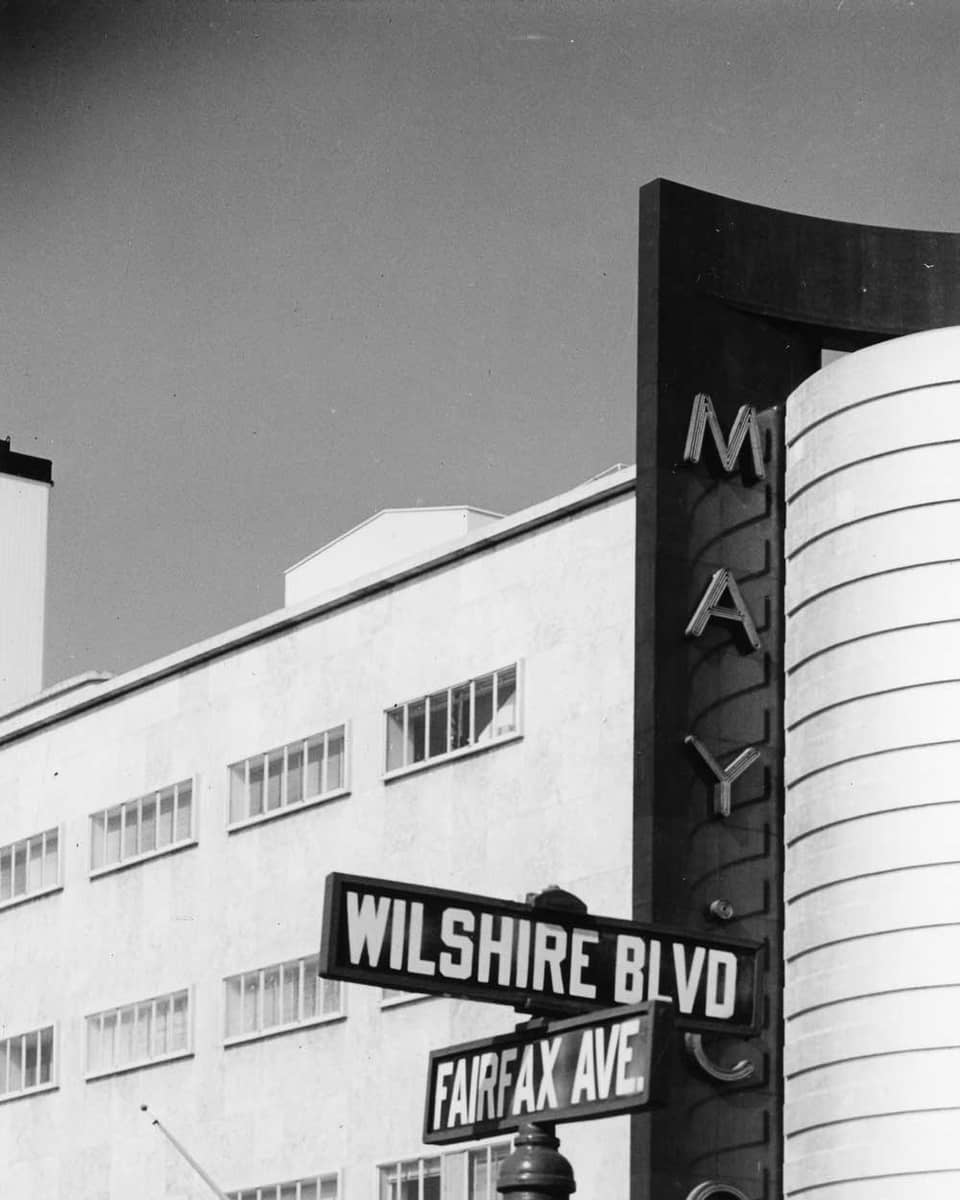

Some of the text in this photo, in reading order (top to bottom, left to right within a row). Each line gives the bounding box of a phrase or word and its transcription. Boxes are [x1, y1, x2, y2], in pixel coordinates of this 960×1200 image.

[346, 891, 738, 1019] WILSHIRE BLVD
[433, 1019, 644, 1131] FAIRFAX AVE.
